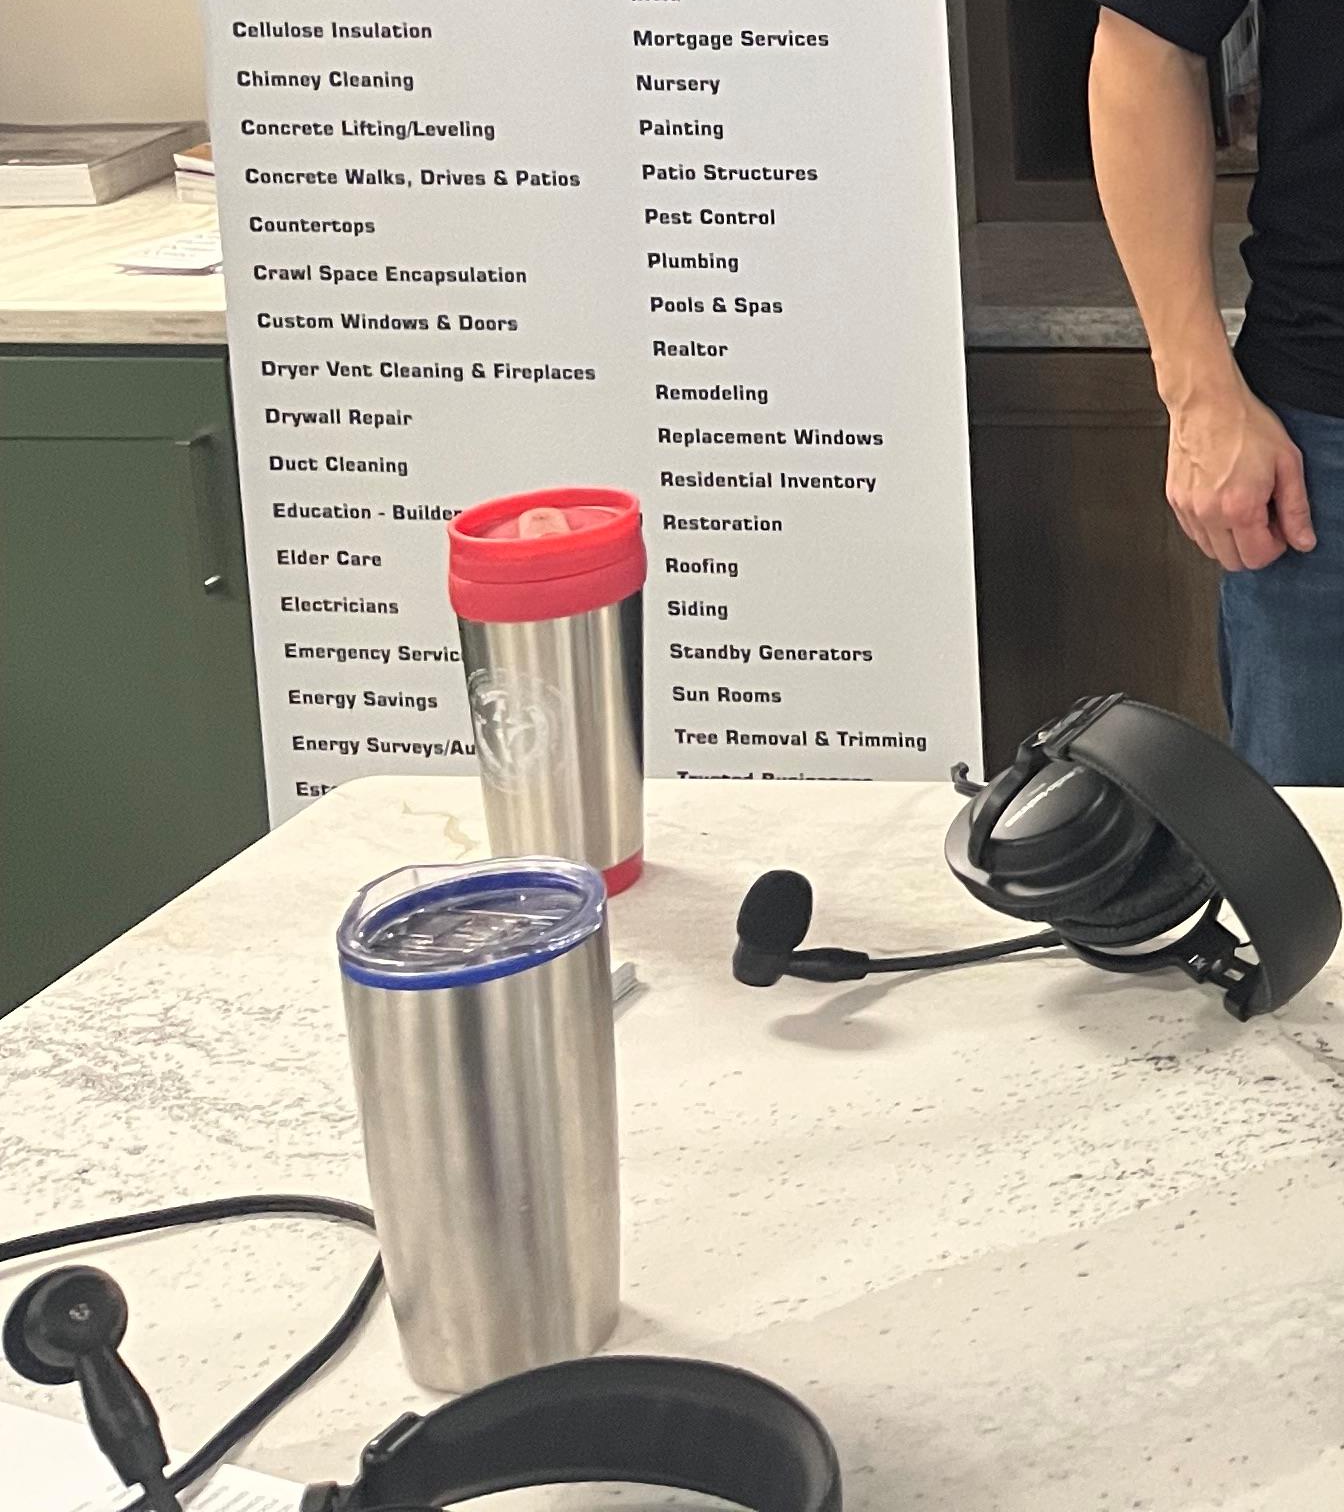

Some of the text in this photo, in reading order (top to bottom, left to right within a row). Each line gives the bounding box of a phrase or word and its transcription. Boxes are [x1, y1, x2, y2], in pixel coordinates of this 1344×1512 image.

[233, 21, 432, 38] Cellulose Insulation
[633, 30, 829, 50] Mortgage Services
[636, 75, 720, 95] Nursery
[241, 119, 495, 141] Concrete Lifting/Leveling
[639, 119, 723, 140] Painting
[249, 216, 375, 237] Countertops
[647, 252, 738, 273] Plumbing
[653, 340, 728, 357] Realtor
[261, 361, 596, 383] Dryer Vent Cleaning & Fireplaces
[656, 384, 768, 405] Remodeling
[269, 456, 408, 477] Duct Cleaning
[666, 558, 738, 577] Roofing
[281, 596, 399, 614] Electricians
[668, 600, 728, 620] Siding
[284, 643, 459, 664] Emergency Servic
[674, 729, 926, 752] Tree Removal & Trimming
